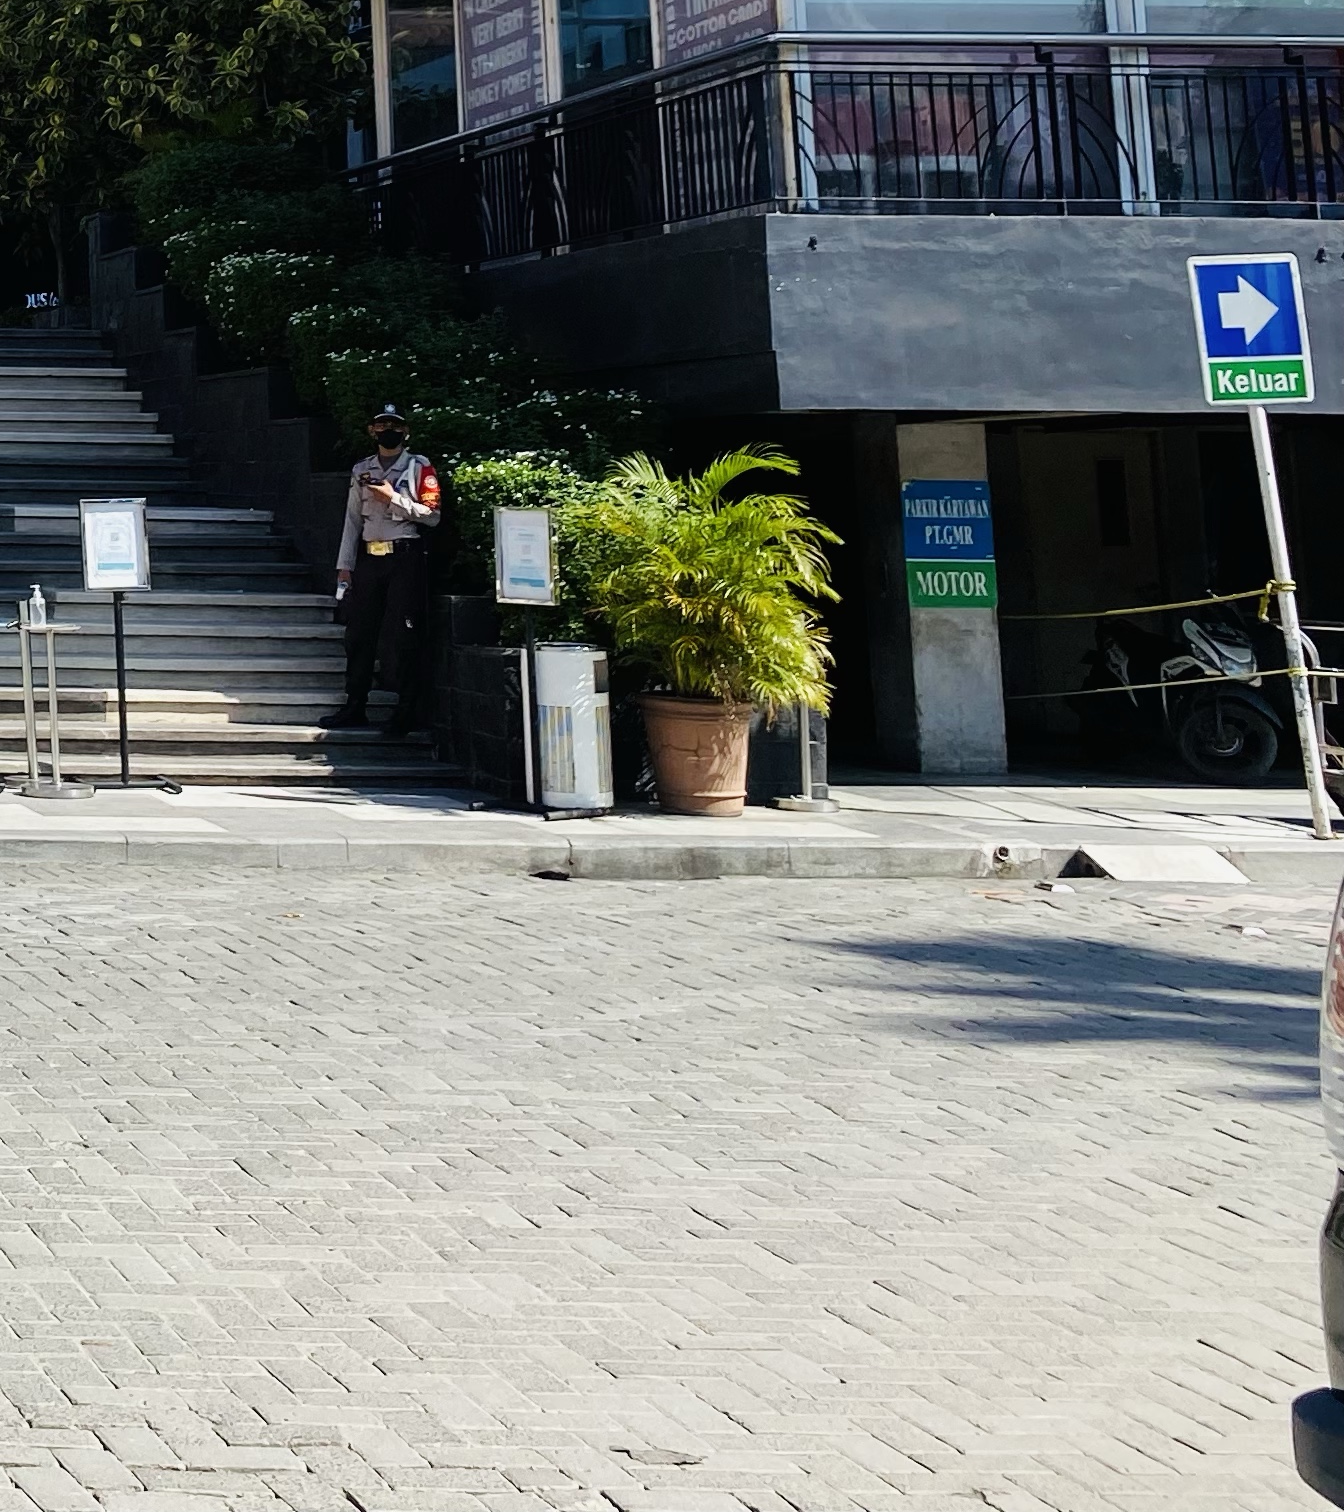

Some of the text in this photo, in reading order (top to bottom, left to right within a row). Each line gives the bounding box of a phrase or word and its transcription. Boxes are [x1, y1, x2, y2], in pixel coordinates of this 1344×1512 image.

[1216, 368, 1300, 394] Keluar
[904, 498, 989, 519] PARKIR KARYAWAN
[925, 525, 974, 545] PT.GMR
[916, 571, 989, 597] MOTOR
